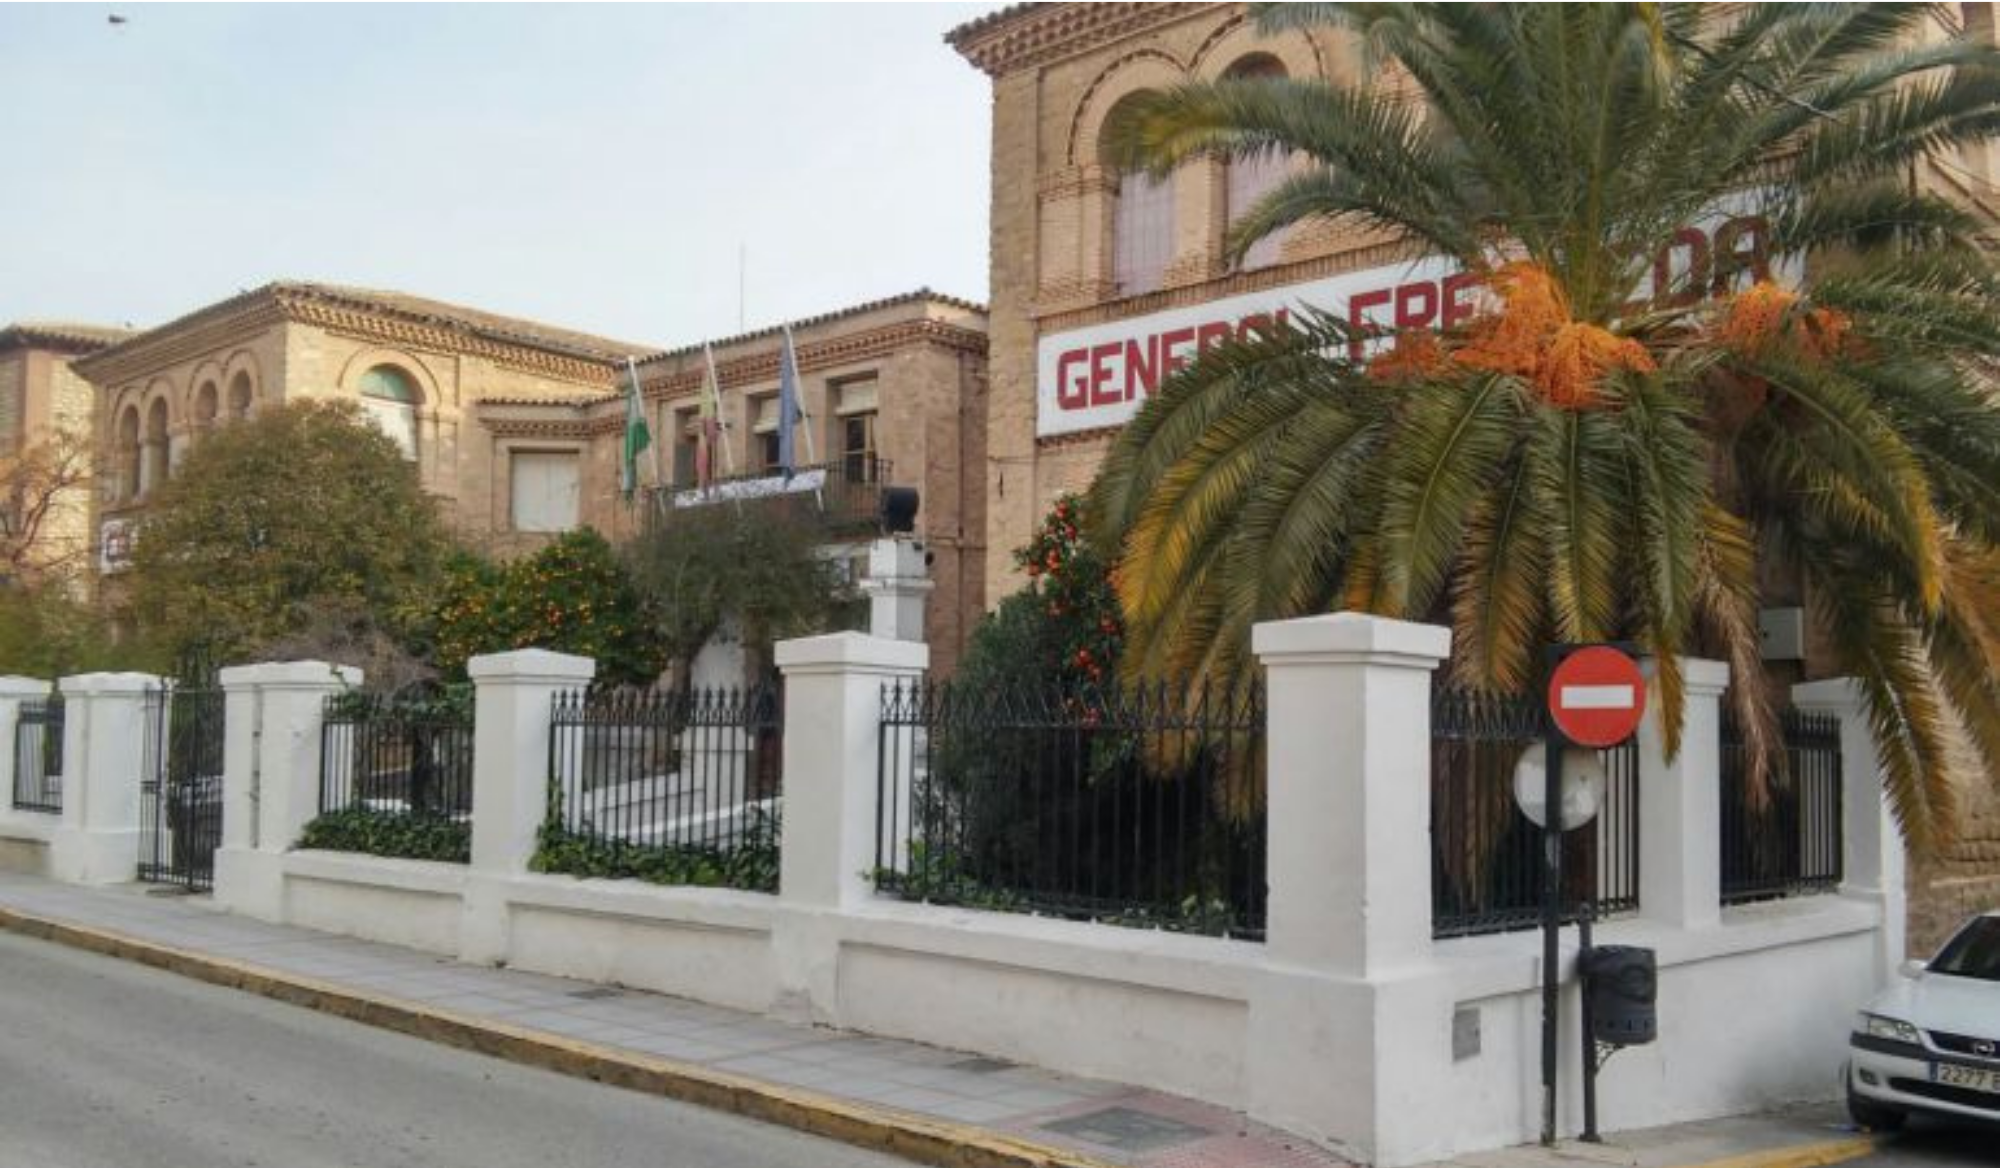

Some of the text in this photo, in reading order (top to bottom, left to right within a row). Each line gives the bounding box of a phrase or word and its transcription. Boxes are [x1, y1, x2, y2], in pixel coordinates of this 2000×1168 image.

[1056, 215, 1772, 411] GENER FREDA
[1940, 1066, 1985, 1086] 2277
